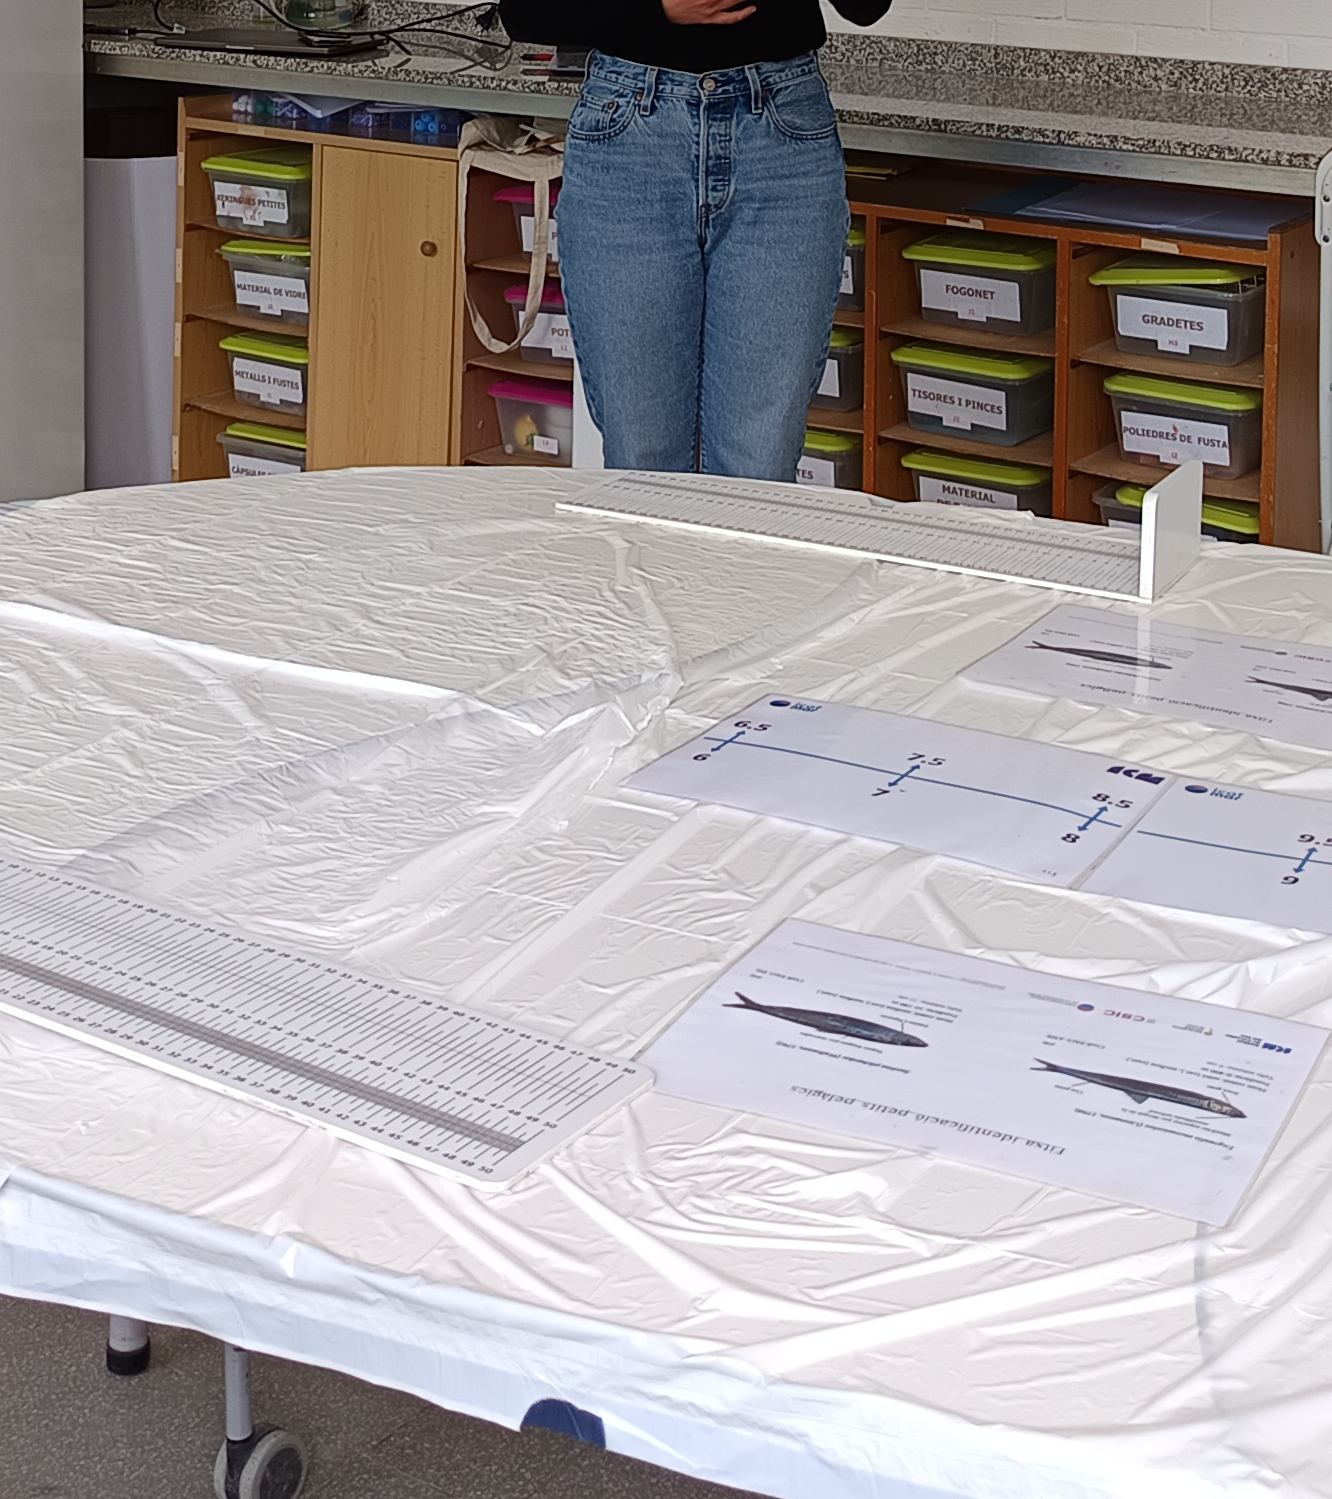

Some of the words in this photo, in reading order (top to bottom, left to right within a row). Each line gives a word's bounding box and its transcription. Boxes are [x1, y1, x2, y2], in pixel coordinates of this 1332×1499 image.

[257, 198, 286, 210] PETITES
[236, 283, 272, 295] MATERIAL
[273, 287, 283, 297] DE
[284, 289, 307, 300] VIDRE
[945, 284, 996, 300] FOGONET
[1141, 313, 1204, 332] GRADETES
[235, 369, 267, 383] METALLS
[272, 377, 300, 390] FUSTES
[911, 387, 956, 405] TISORES
[965, 398, 1003, 415] PINCES
[1123, 425, 1178, 441] POLIEDRES
[1179, 434, 1193, 444] DE
[1197, 436, 1228, 449] FUSTA
[941, 484, 996, 504] MATERIAL
[733, 719, 771, 733] 6.5
[692, 753, 711, 762] 6
[906, 752, 947, 767] 7.5
[871, 788, 891, 798] 7
[1091, 792, 1134, 810] 8.5
[1060, 832, 1081, 844] 8
[1280, 875, 1300, 886] 9
